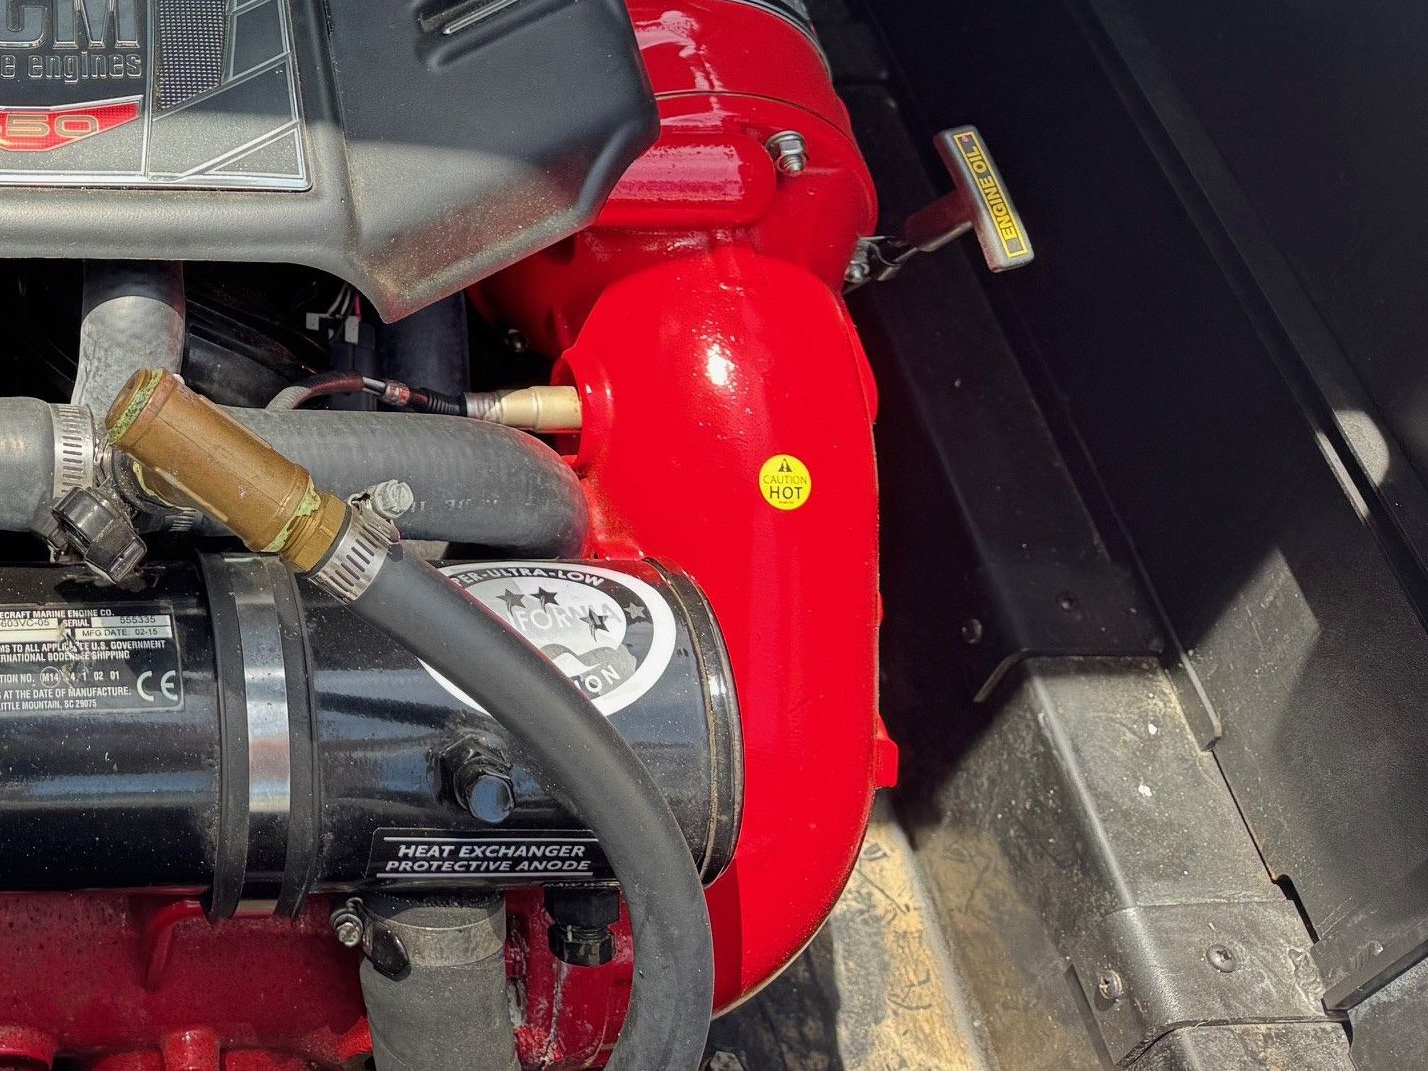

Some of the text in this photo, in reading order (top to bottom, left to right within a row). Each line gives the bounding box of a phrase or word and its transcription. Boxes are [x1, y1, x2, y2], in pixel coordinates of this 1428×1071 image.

[27, 51, 143, 85] engines
[966, 145, 1018, 241] ENGINE OIL
[762, 474, 807, 485] CAUTION
[769, 485, 803, 500] HOT
[33, 609, 65, 619] MARINE
[67, 609, 98, 618] ENGINE
[100, 608, 115, 617] CO.
[62, 618, 90, 628] SERIAL
[82, 629, 102, 637] MFG
[134, 627, 158, 636] 02-15
[12, 643, 23, 653] TO
[24, 643, 40, 652] ALL
[91, 641, 109, 650] U.S.
[110, 639, 166, 649] GOVERNMENT
[92, 650, 130, 660] SHIPPING
[20, 673, 35, 683] NO.
[42, 672, 59, 682] M14
[93, 671, 104, 681] 02
[110, 671, 120, 680] 01
[136, 669, 179, 702] CE
[3, 690, 14, 700] AT
[15, 689, 31, 699] THE
[33, 689, 54, 698] DATE
[55, 688, 66, 697] OF
[64, 699, 74, 708] SC
[397, 844, 586, 858] HEAT EXCHANGER
[385, 860, 592, 872] PROTECTIVE ANODE
